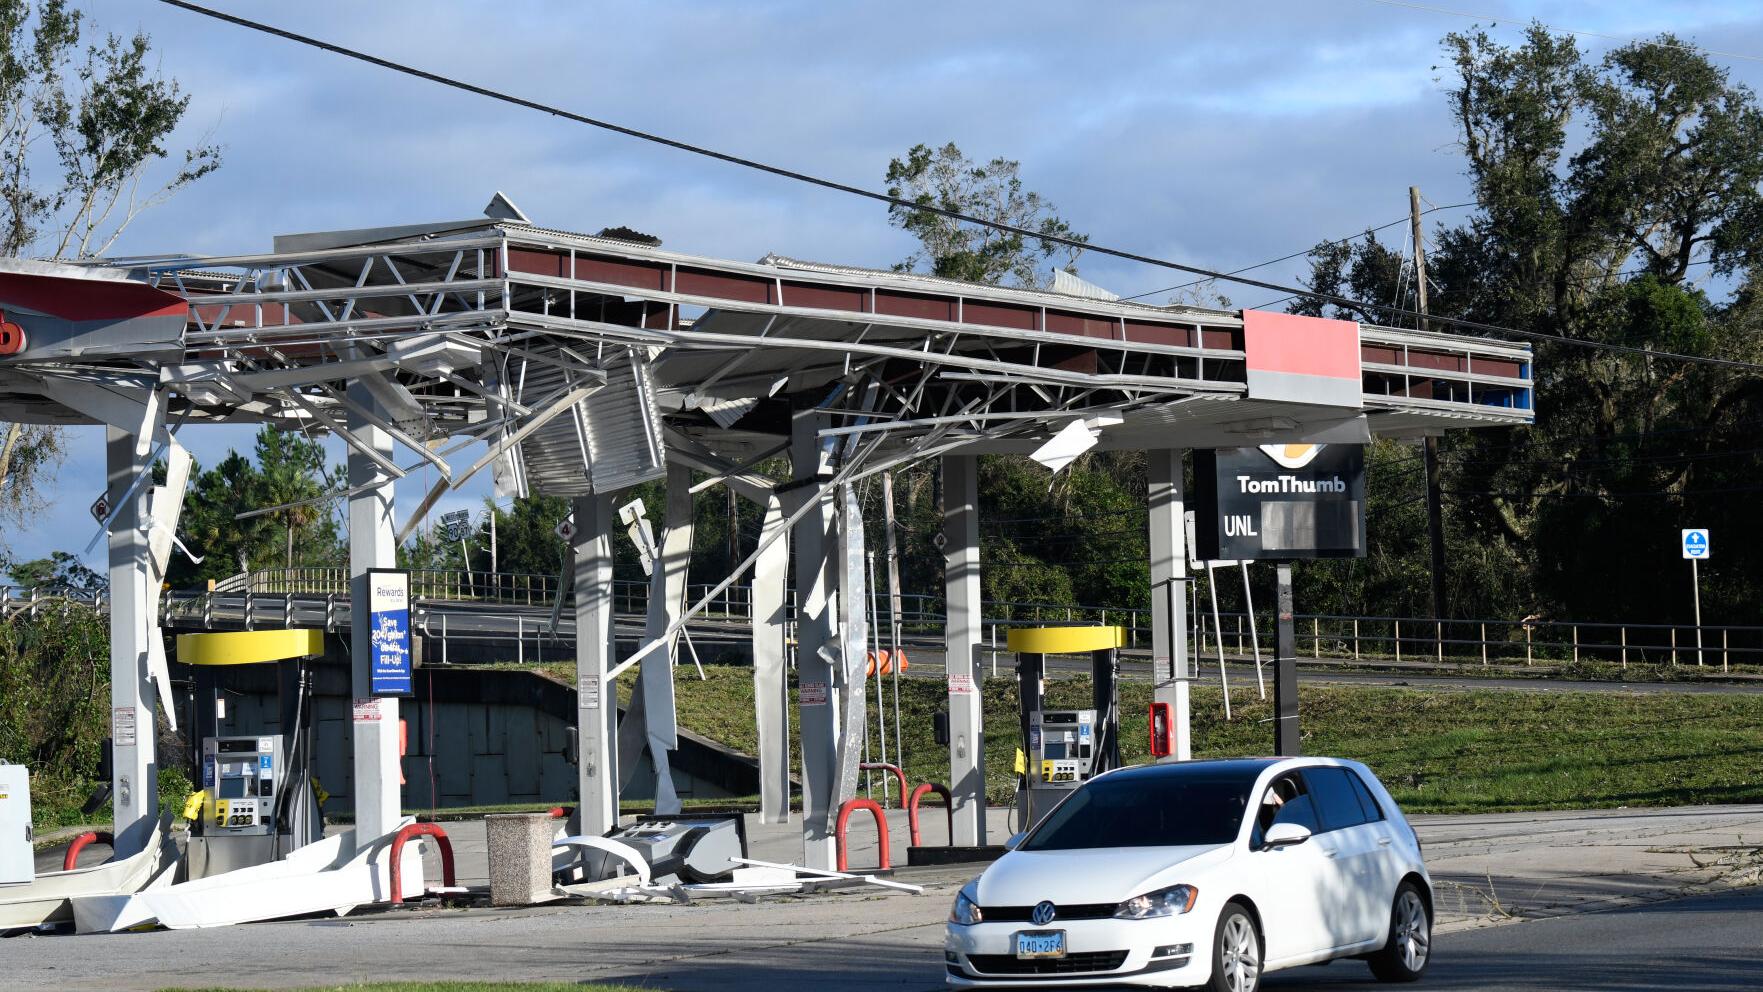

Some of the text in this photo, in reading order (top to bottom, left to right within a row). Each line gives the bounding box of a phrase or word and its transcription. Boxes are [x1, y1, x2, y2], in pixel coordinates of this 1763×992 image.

[1236, 475, 1346, 493] TomThumb
[562, 523, 570, 535] 4
[1224, 515, 1257, 537] UNL
[377, 587, 404, 597] Rewards
[382, 617, 397, 627] Save
[380, 655, 402, 666] Fill-Up!
